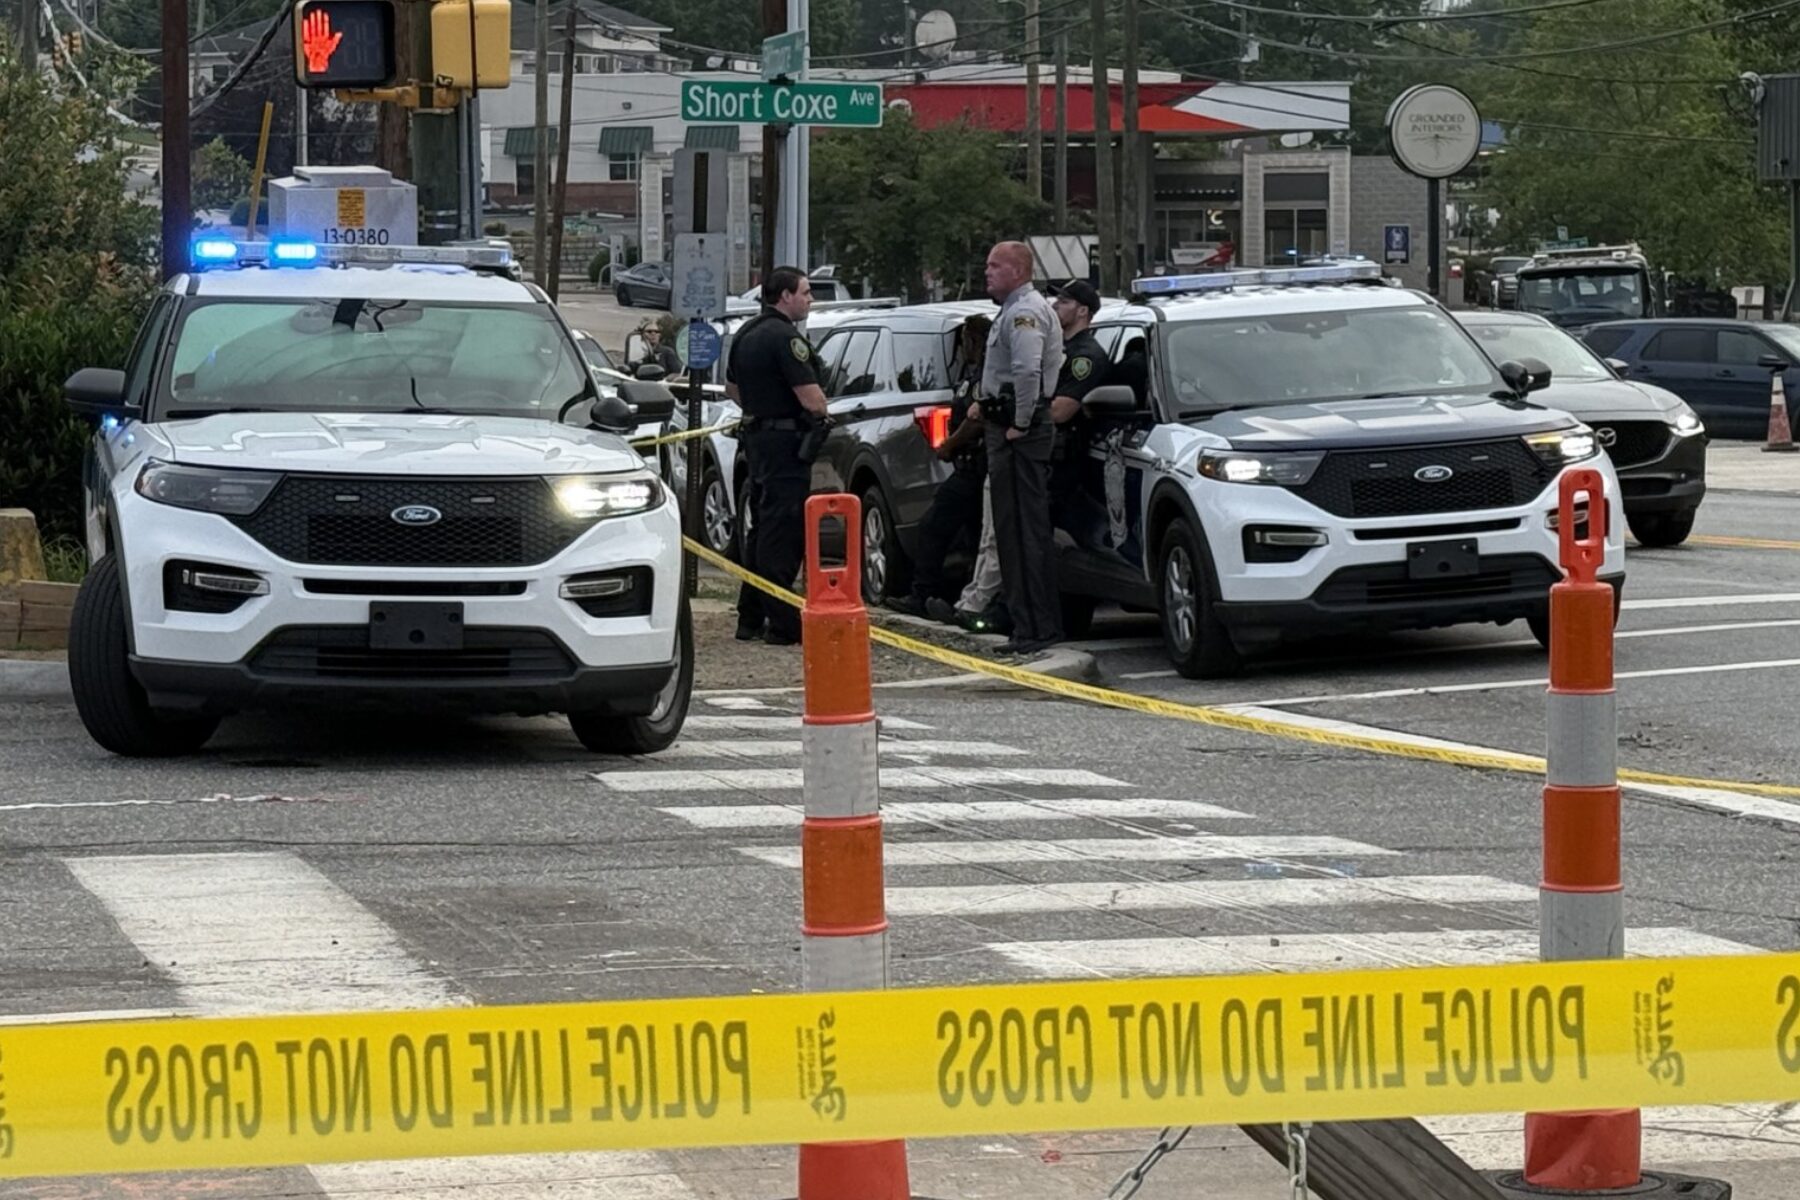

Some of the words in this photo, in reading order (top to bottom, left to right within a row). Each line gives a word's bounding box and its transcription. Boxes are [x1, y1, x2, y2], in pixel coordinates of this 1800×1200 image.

[687, 84, 763, 118] Short
[773, 87, 838, 120] Coxe
[849, 89, 875, 106] Ave
[1409, 113, 1465, 123] GROUNDED
[323, 228, 389, 245] 13-0380
